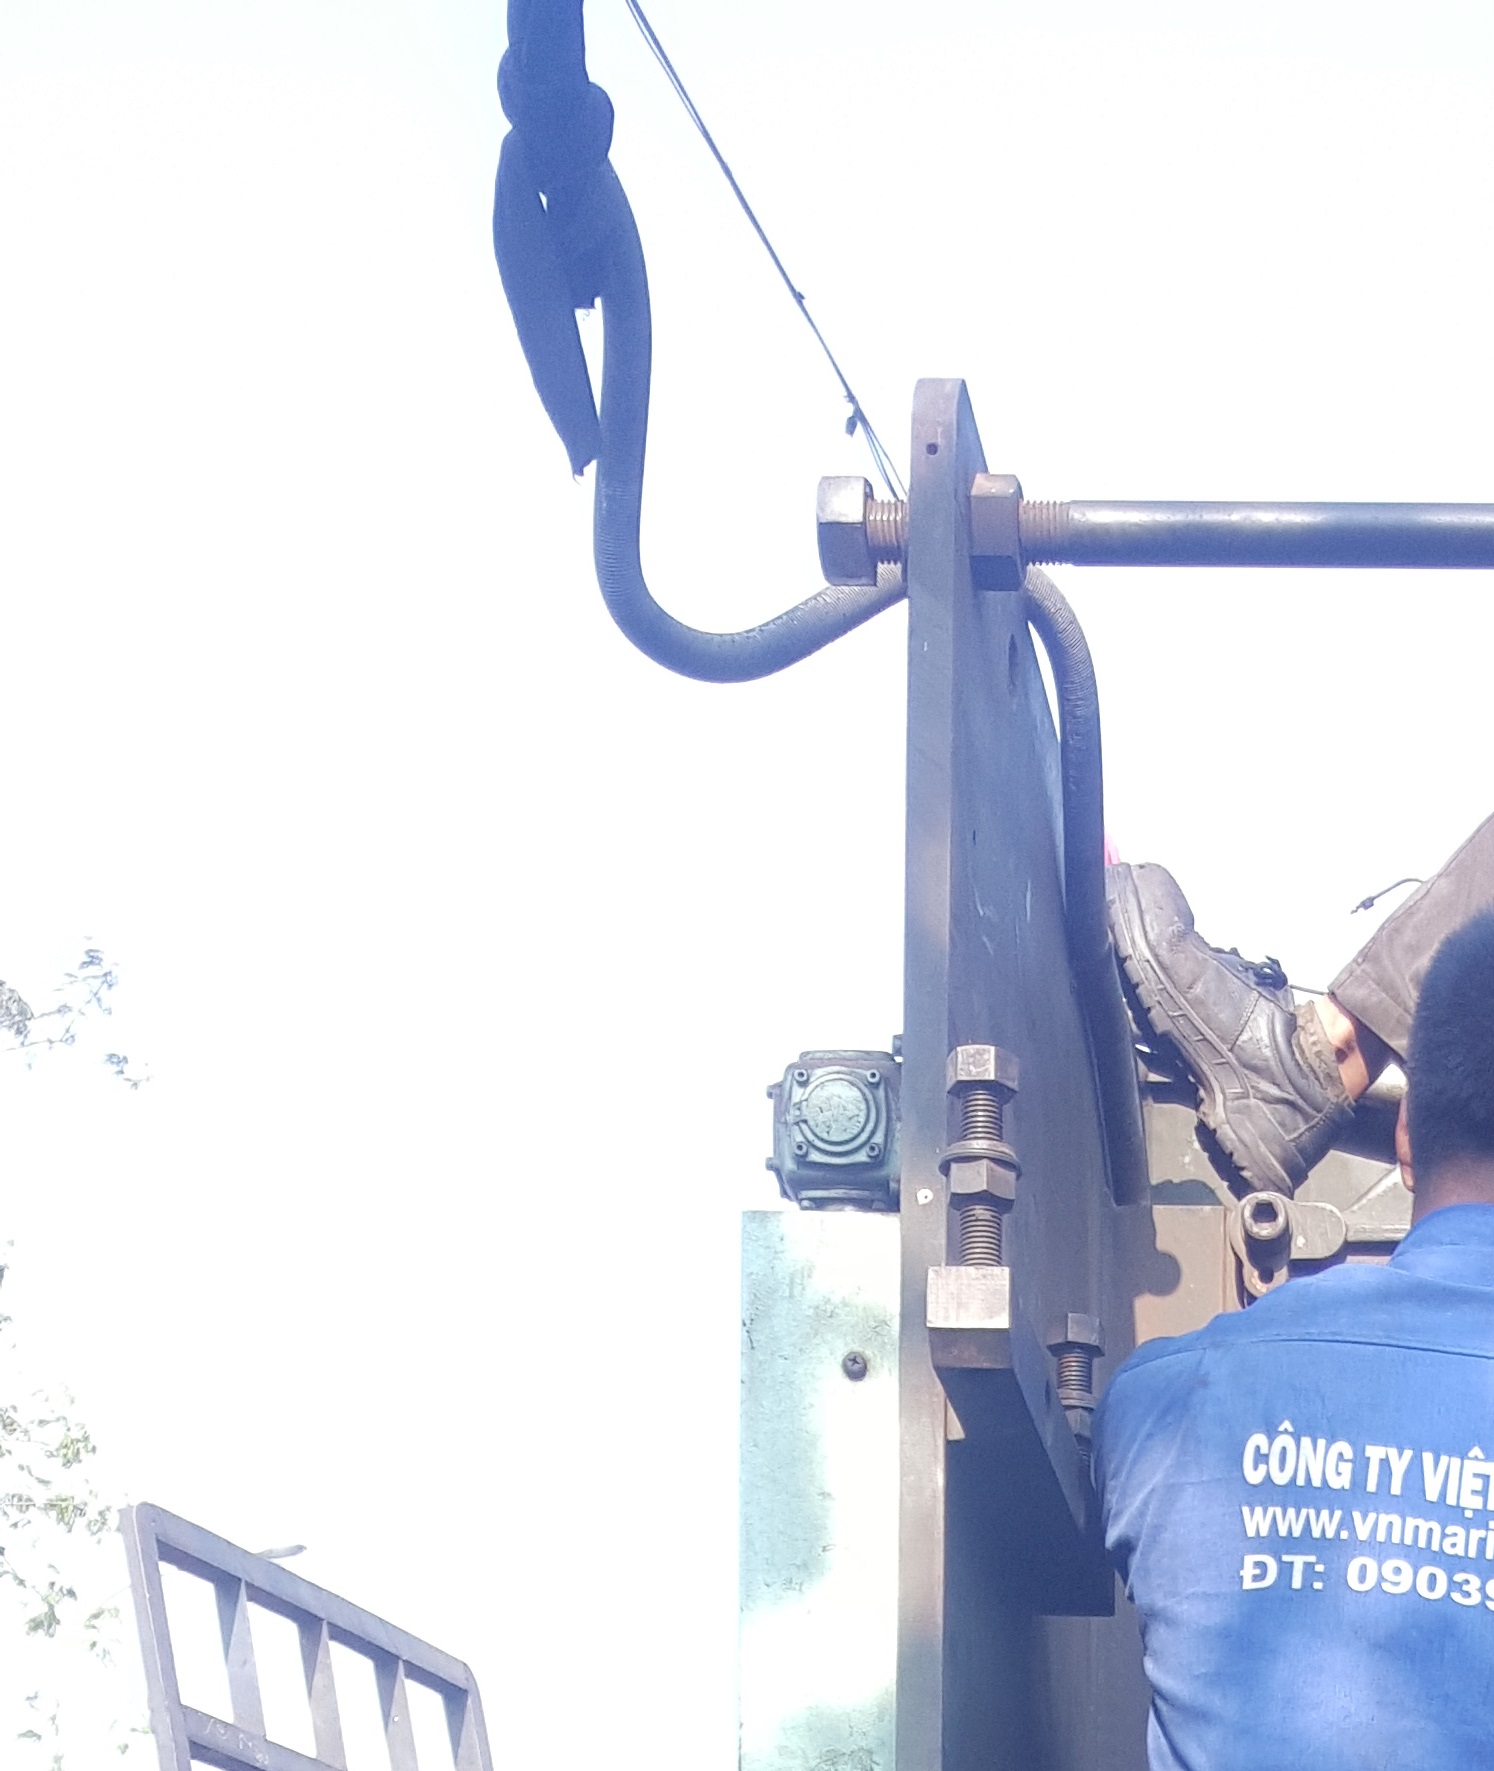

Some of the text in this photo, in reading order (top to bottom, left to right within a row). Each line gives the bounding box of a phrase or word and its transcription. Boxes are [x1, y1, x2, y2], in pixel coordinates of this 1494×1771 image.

[1243, 1420, 1354, 1490] CÔNG
[1365, 1446, 1413, 1496] TY
[1240, 1554, 1325, 1590] ĐT:
